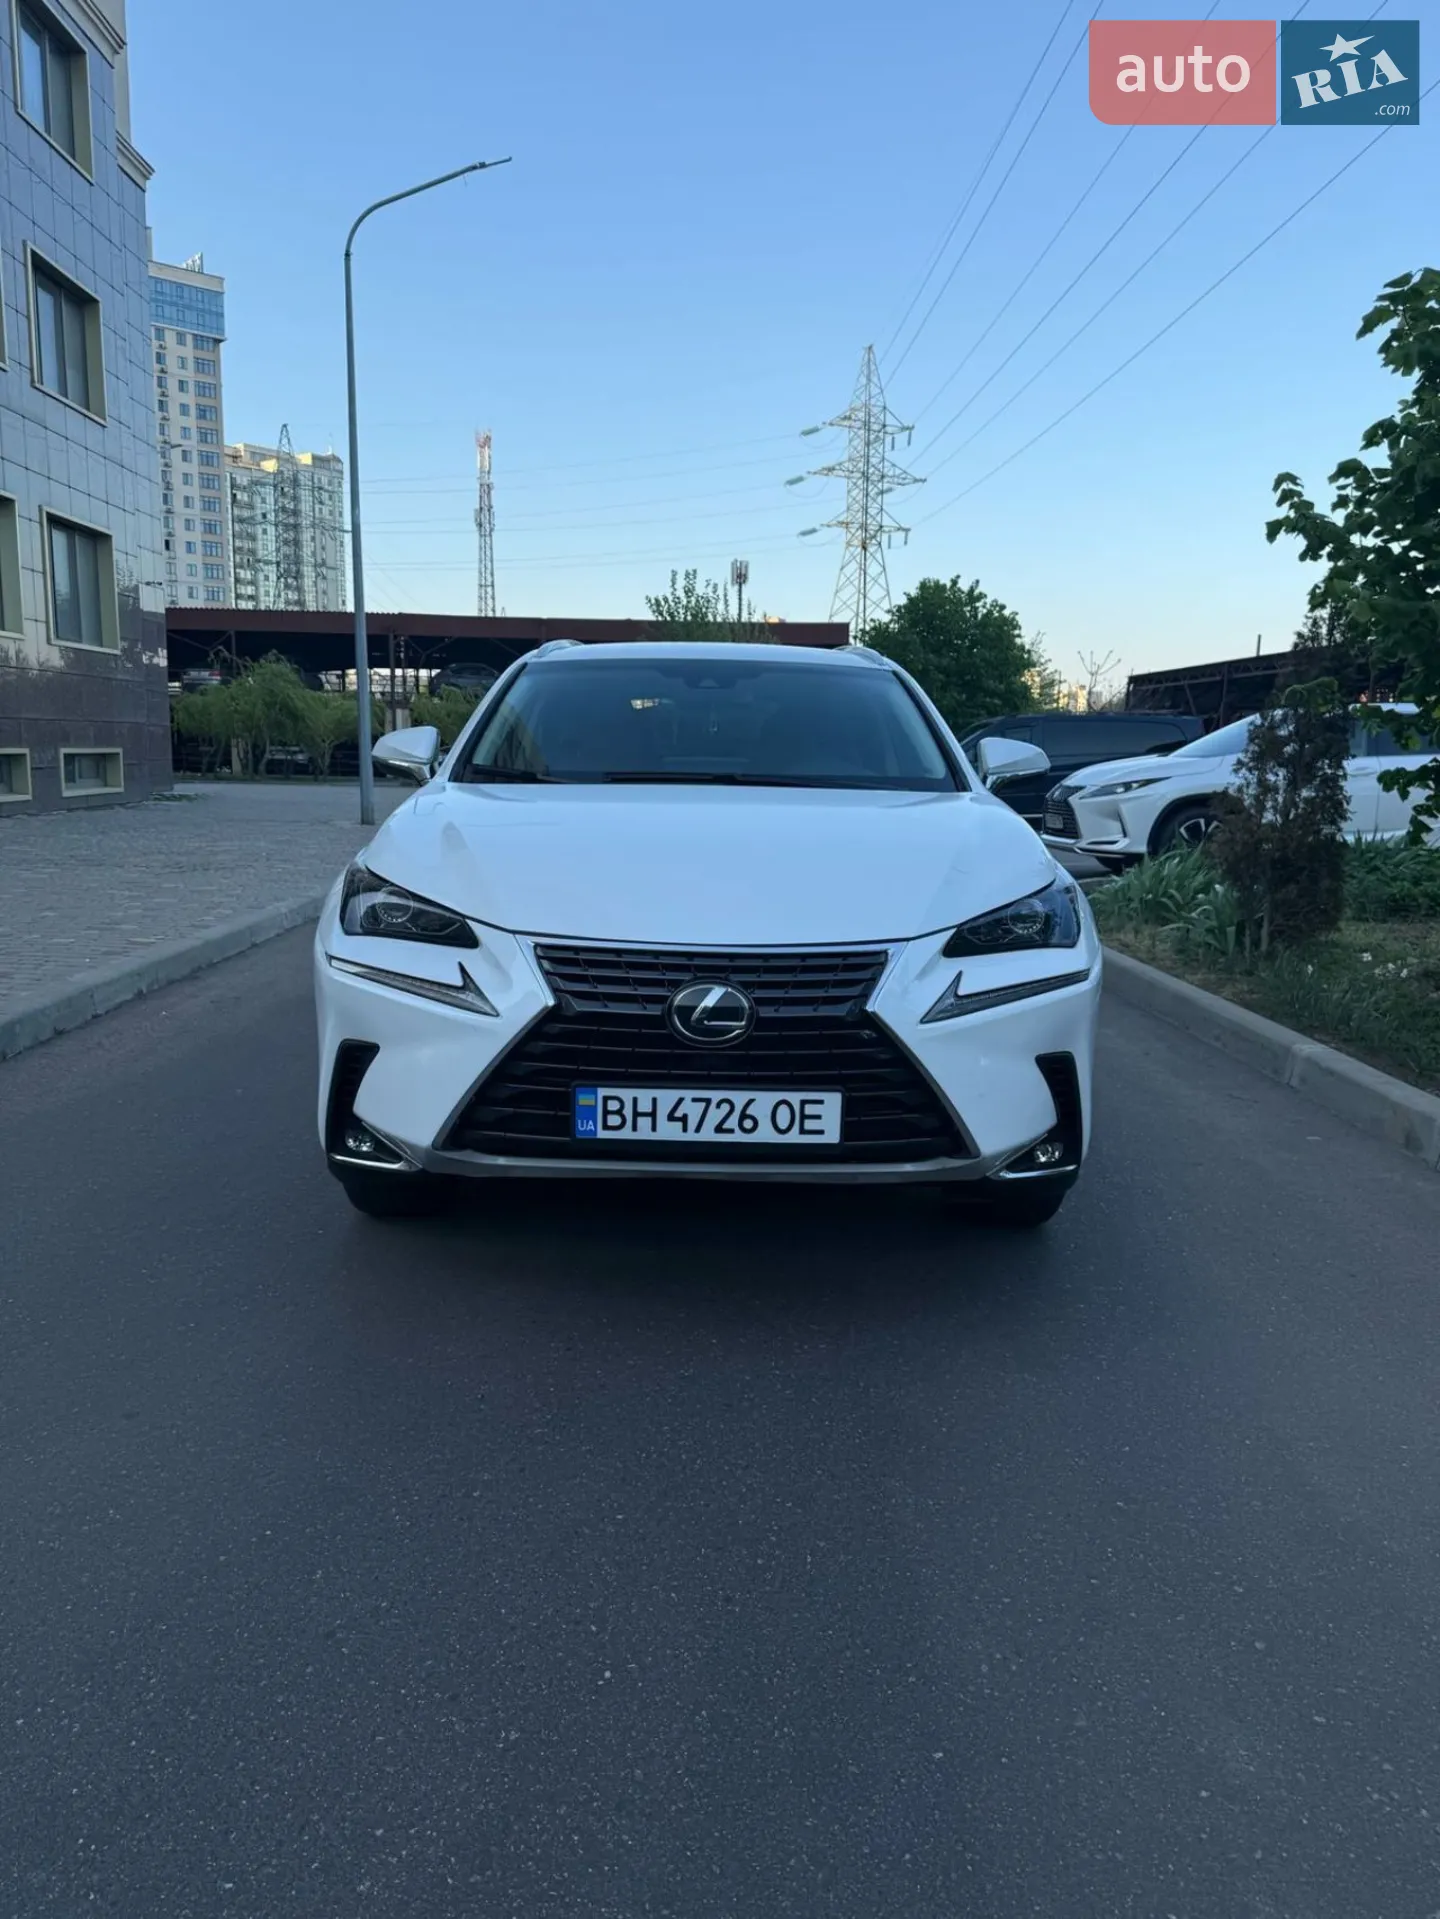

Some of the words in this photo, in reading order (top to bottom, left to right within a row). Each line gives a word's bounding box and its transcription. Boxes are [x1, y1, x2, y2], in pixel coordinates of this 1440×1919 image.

[577, 1120, 595, 1131] UA
[601, 1095, 658, 1133] BH
[666, 1097, 759, 1134] 4726
[770, 1098, 825, 1135] OE
